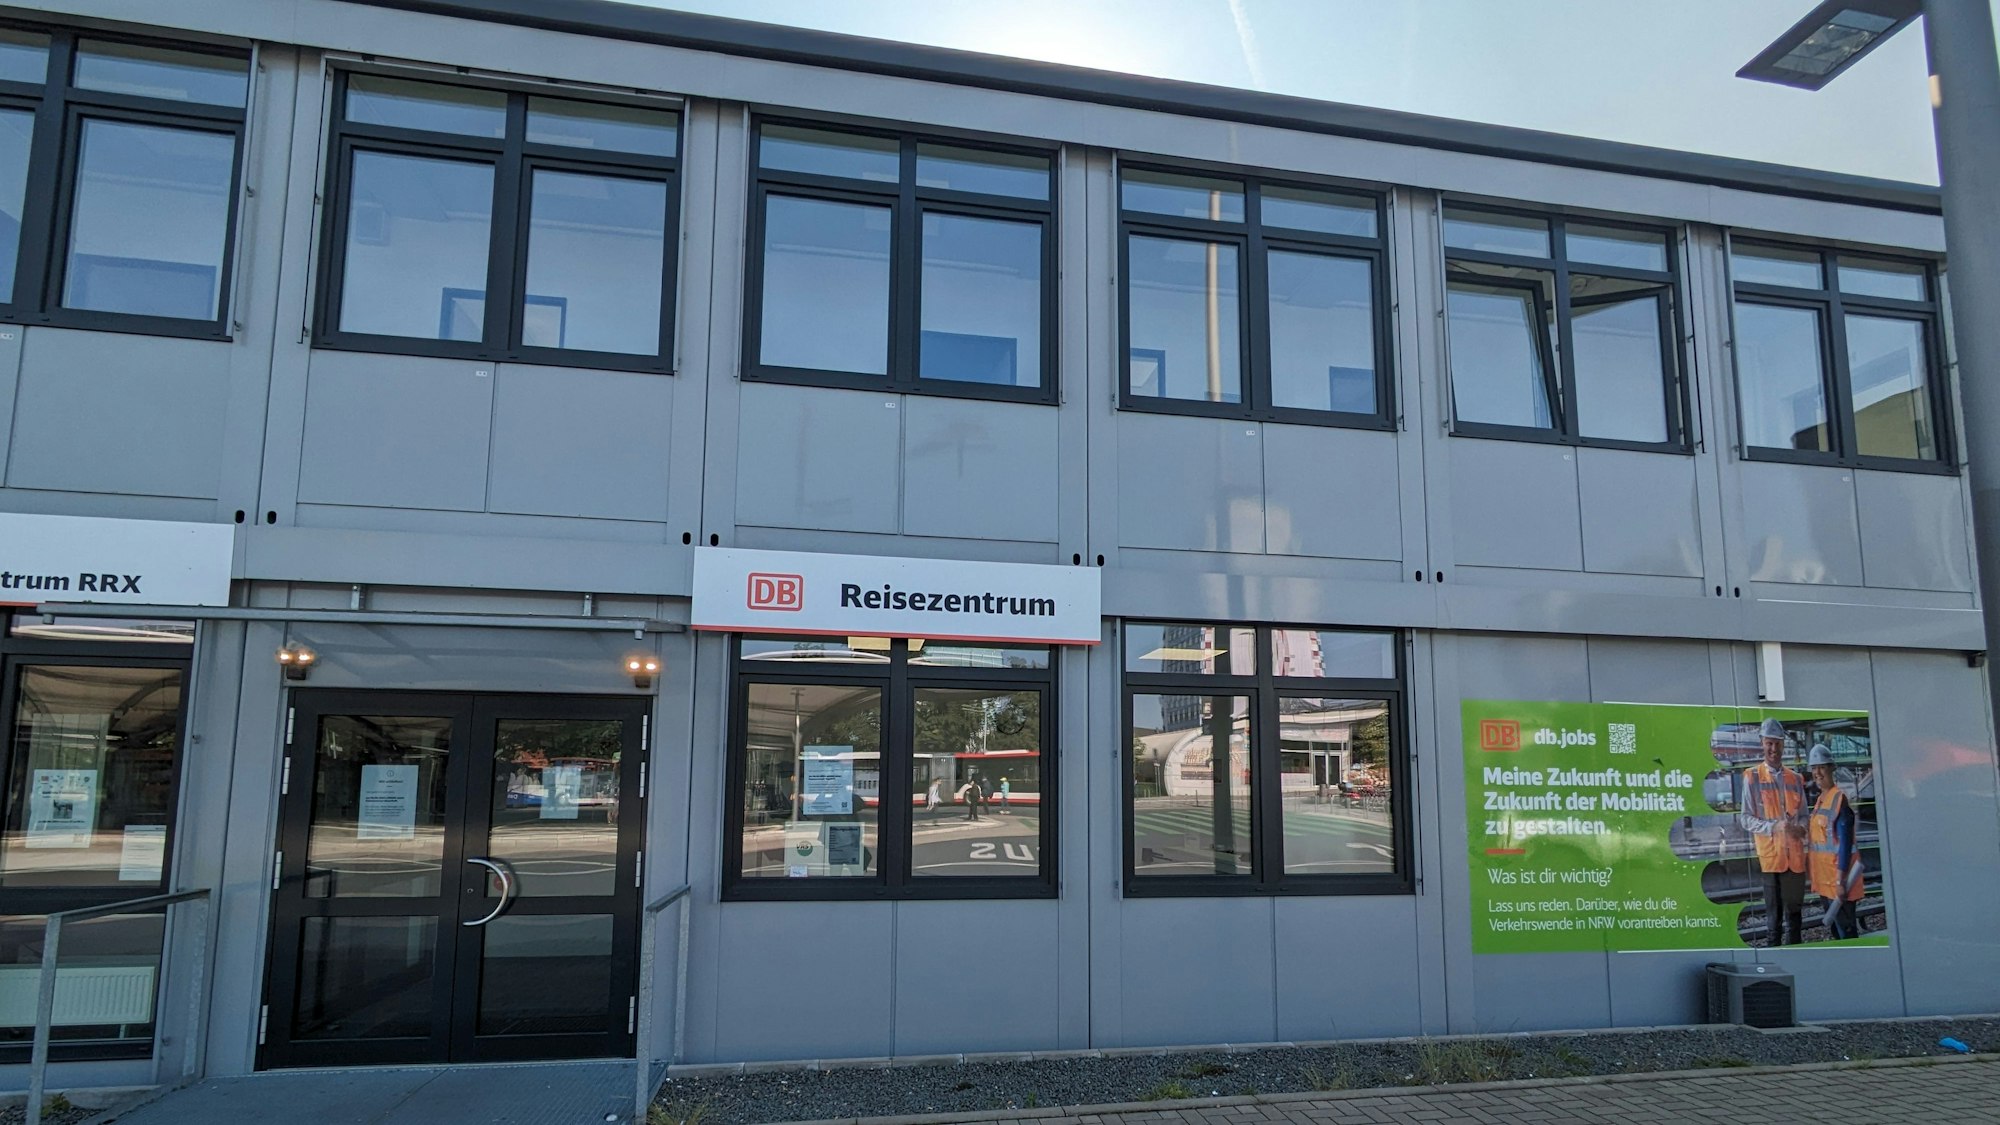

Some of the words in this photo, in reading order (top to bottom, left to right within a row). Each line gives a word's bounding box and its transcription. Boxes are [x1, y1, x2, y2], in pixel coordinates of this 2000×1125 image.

[1, 571, 70, 590] trum
[78, 573, 142, 593] RRX
[754, 580, 796, 605] DB
[841, 583, 1055, 616] Reisezentrum
[1486, 726, 1515, 746] DB
[1534, 728, 1597, 748] db.jobs
[1483, 767, 1543, 786] Meine
[1547, 768, 1622, 787] Zukunft
[1626, 770, 1661, 788] und
[1664, 769, 1693, 788] die
[1484, 792, 1562, 811] Zukunft
[1565, 793, 1597, 811] der
[1601, 793, 1685, 811] Mobilität
[1485, 820, 1509, 836] zu
[1513, 817, 1611, 839] gestalten.
[1487, 868, 1517, 884] Was
[1520, 868, 1537, 884] ist
[1539, 868, 1557, 883] dir
[1560, 867, 1613, 887] wichtig?
[1488, 899, 1513, 912] Lass
[1516, 900, 1536, 912] uns
[1538, 899, 1573, 911] reden.
[1576, 898, 1621, 913] Darüber,
[1623, 898, 1642, 910] wie
[1644, 897, 1659, 910] du
[1662, 897, 1677, 910] die
[1489, 916, 1573, 932] Verkehrswende
[1576, 917, 1586, 930] in
[1617, 914, 1683, 930] vorantreiben
[1685, 914, 1722, 929] kannst.
